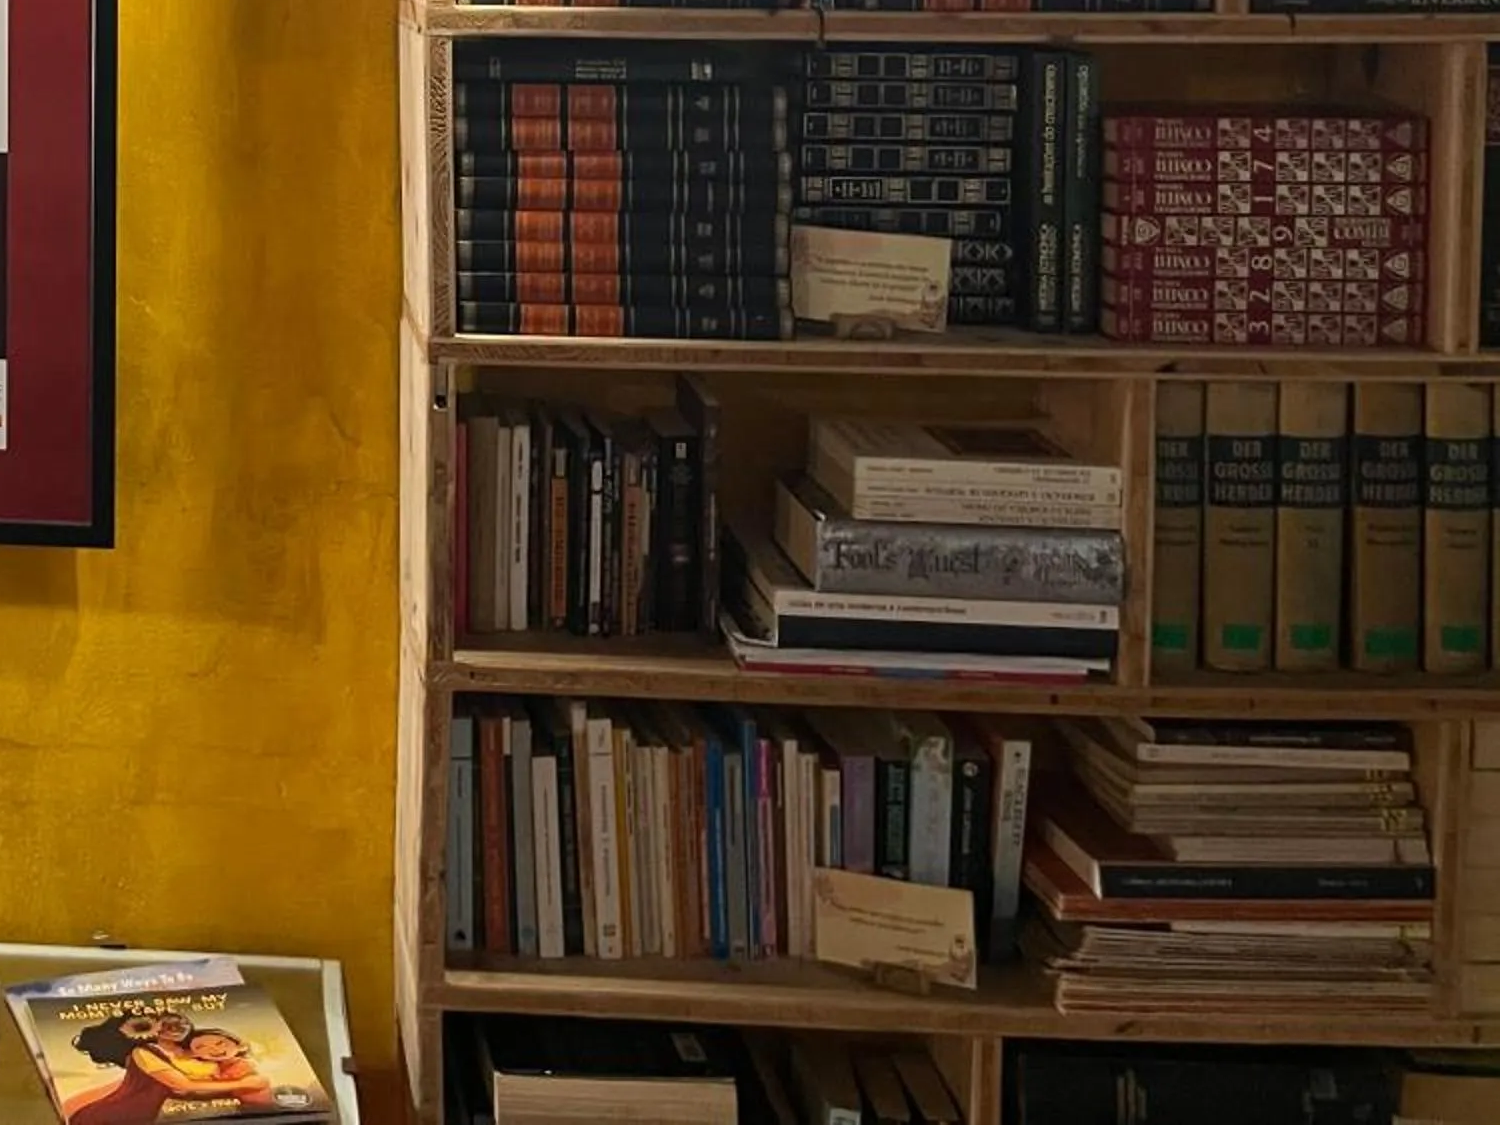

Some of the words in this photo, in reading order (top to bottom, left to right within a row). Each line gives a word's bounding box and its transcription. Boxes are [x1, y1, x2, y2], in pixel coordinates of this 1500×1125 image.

[1253, 124, 1273, 143] 4
[1252, 156, 1275, 176] 7
[1250, 254, 1273, 273] 8
[1249, 286, 1271, 303] 2
[1248, 320, 1271, 337] 3
[1231, 440, 1262, 457] DER
[1299, 441, 1332, 458] DER
[1379, 441, 1409, 457] DER
[1447, 443, 1478, 460] DER
[85, 998, 145, 1012] NEVER
[153, 995, 192, 1008] SAW
[200, 991, 228, 1005] MY
[191, 1001, 227, 1014] BUT
